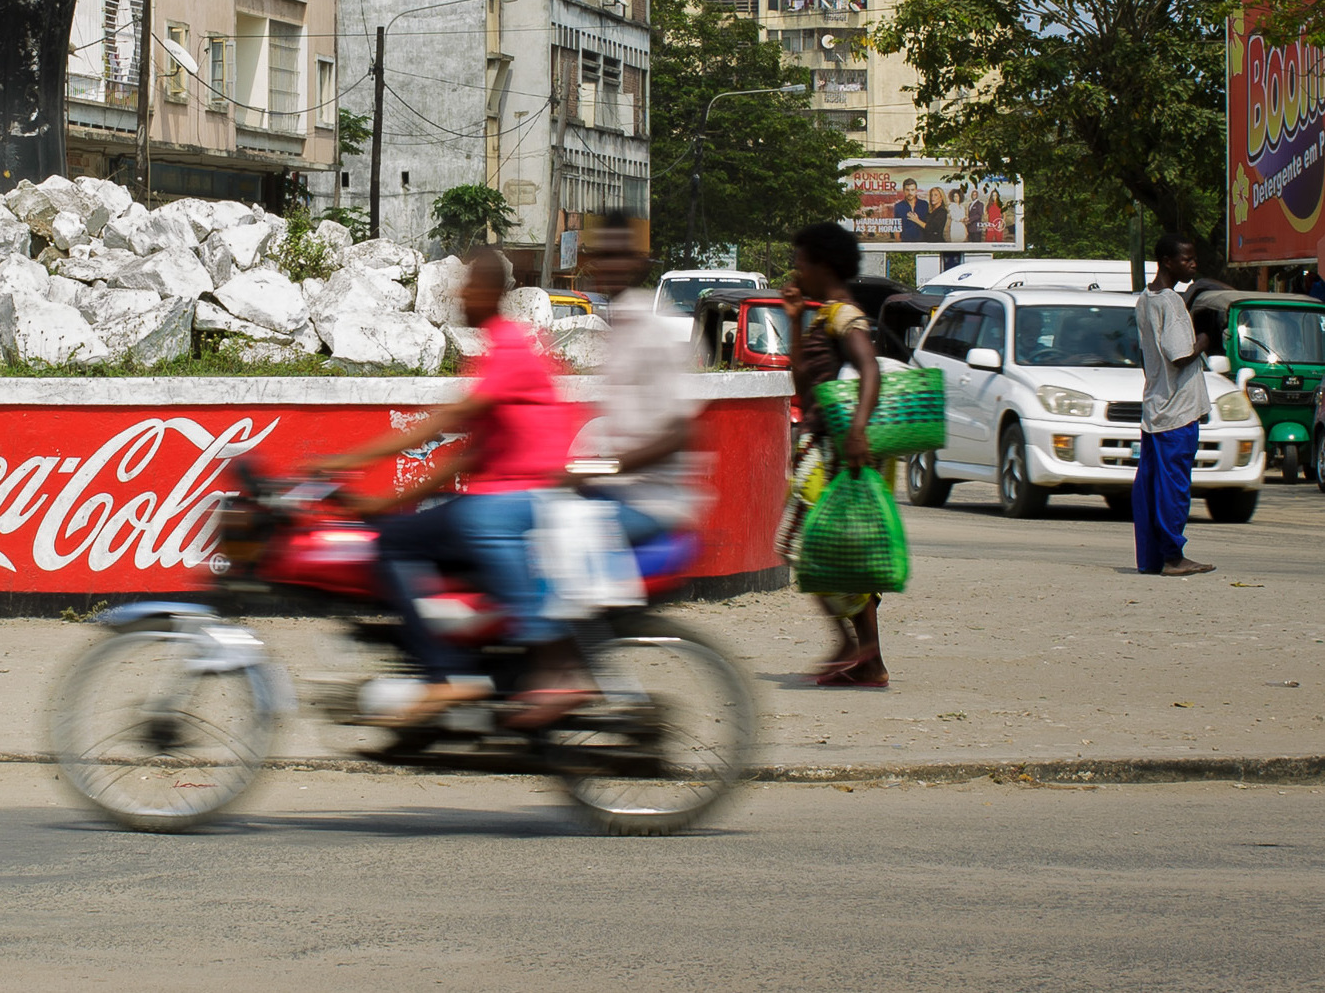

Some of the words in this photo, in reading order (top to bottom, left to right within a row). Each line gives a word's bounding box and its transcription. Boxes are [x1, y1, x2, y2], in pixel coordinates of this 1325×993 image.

[854, 181, 897, 191] MULHER
[1253, 155, 1302, 208] Detergente
[1304, 143, 1318, 168] em
